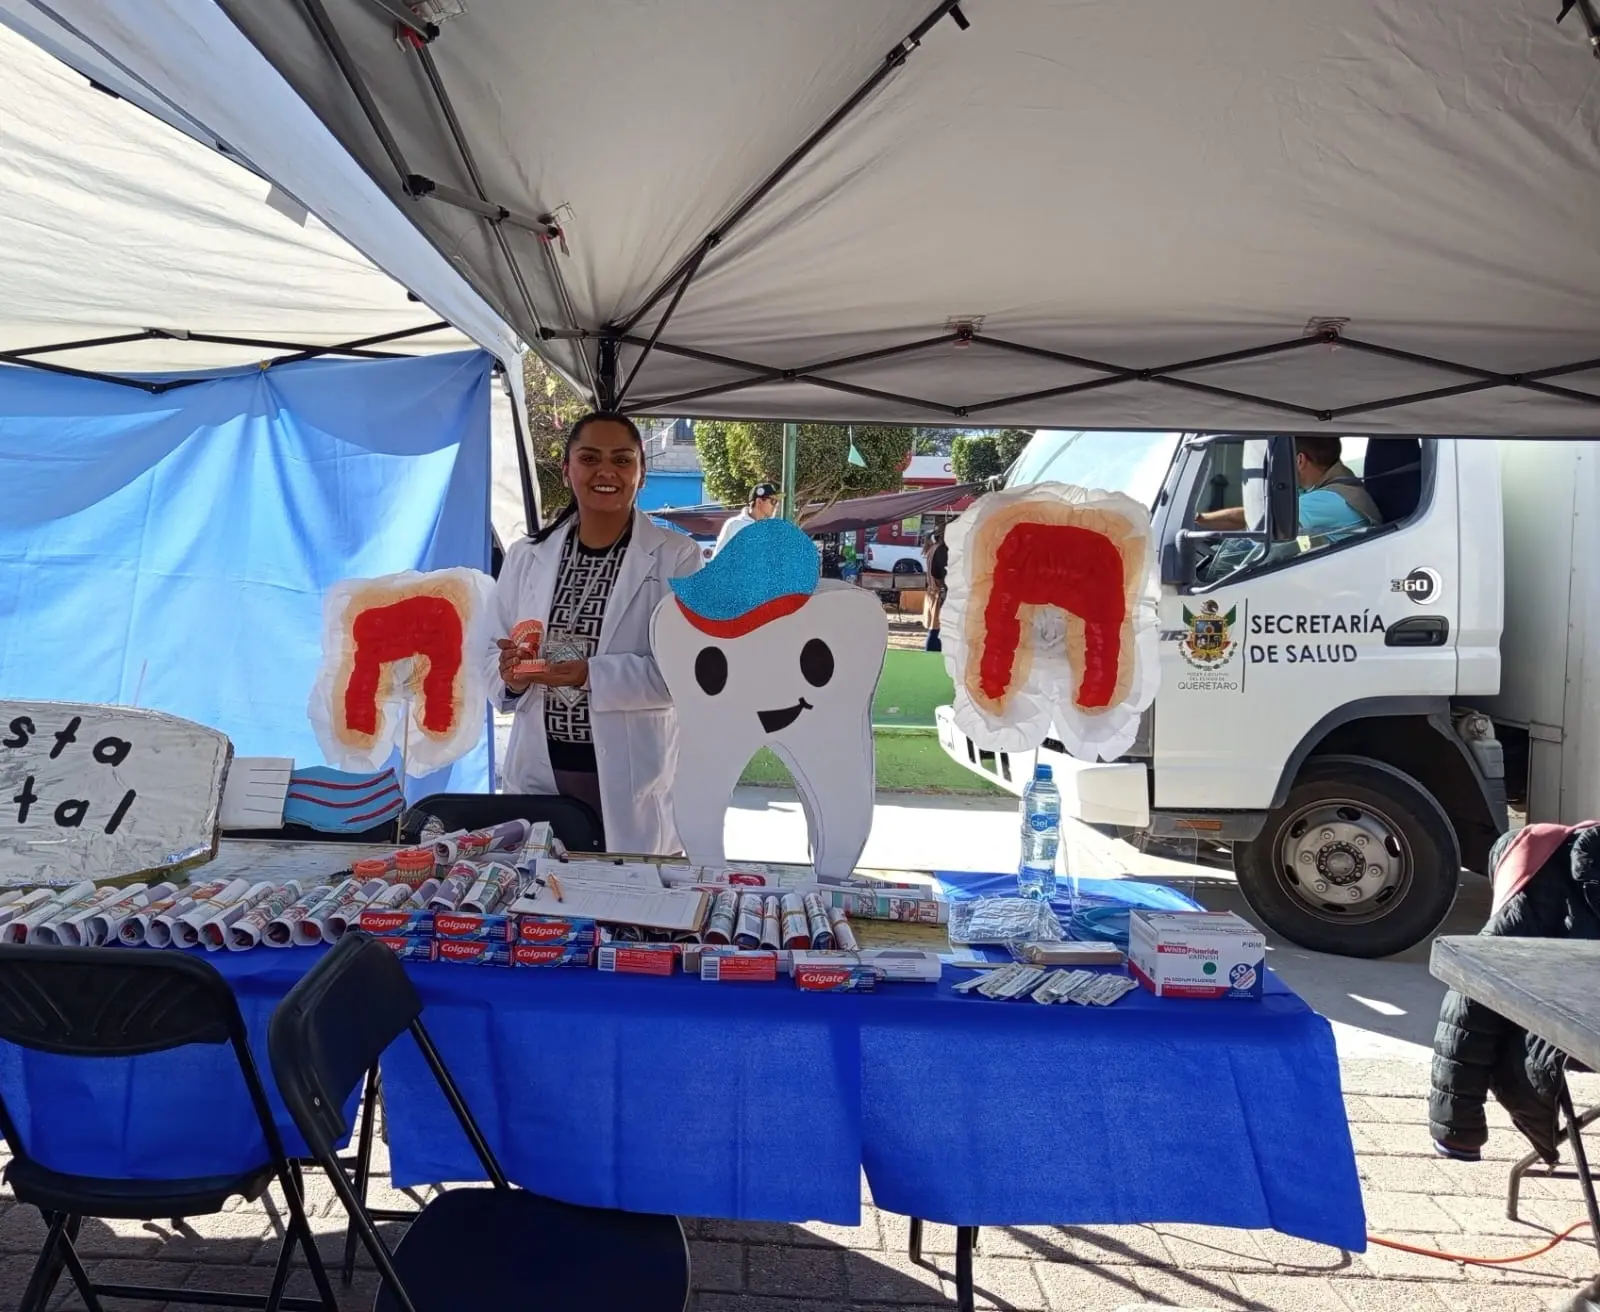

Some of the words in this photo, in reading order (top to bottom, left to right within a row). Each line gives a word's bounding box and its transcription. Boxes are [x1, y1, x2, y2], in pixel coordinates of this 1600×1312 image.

[1391, 579, 1428, 592] 360
[1251, 608, 1386, 634] SECRETARÍA
[1250, 645, 1279, 663] DE
[1286, 644, 1358, 663] SALUD
[3, 716, 132, 767] sta
[13, 775, 136, 834] tal
[361, 917, 403, 927] Colgate
[437, 919, 477, 930] Colgate
[522, 926, 564, 936] Colgate
[441, 944, 480, 954] Colgate
[517, 949, 558, 959] Colgate
[1163, 946, 1187, 954] White
[1188, 947, 1219, 955] Fluoride
[801, 973, 844, 984] Colgate
